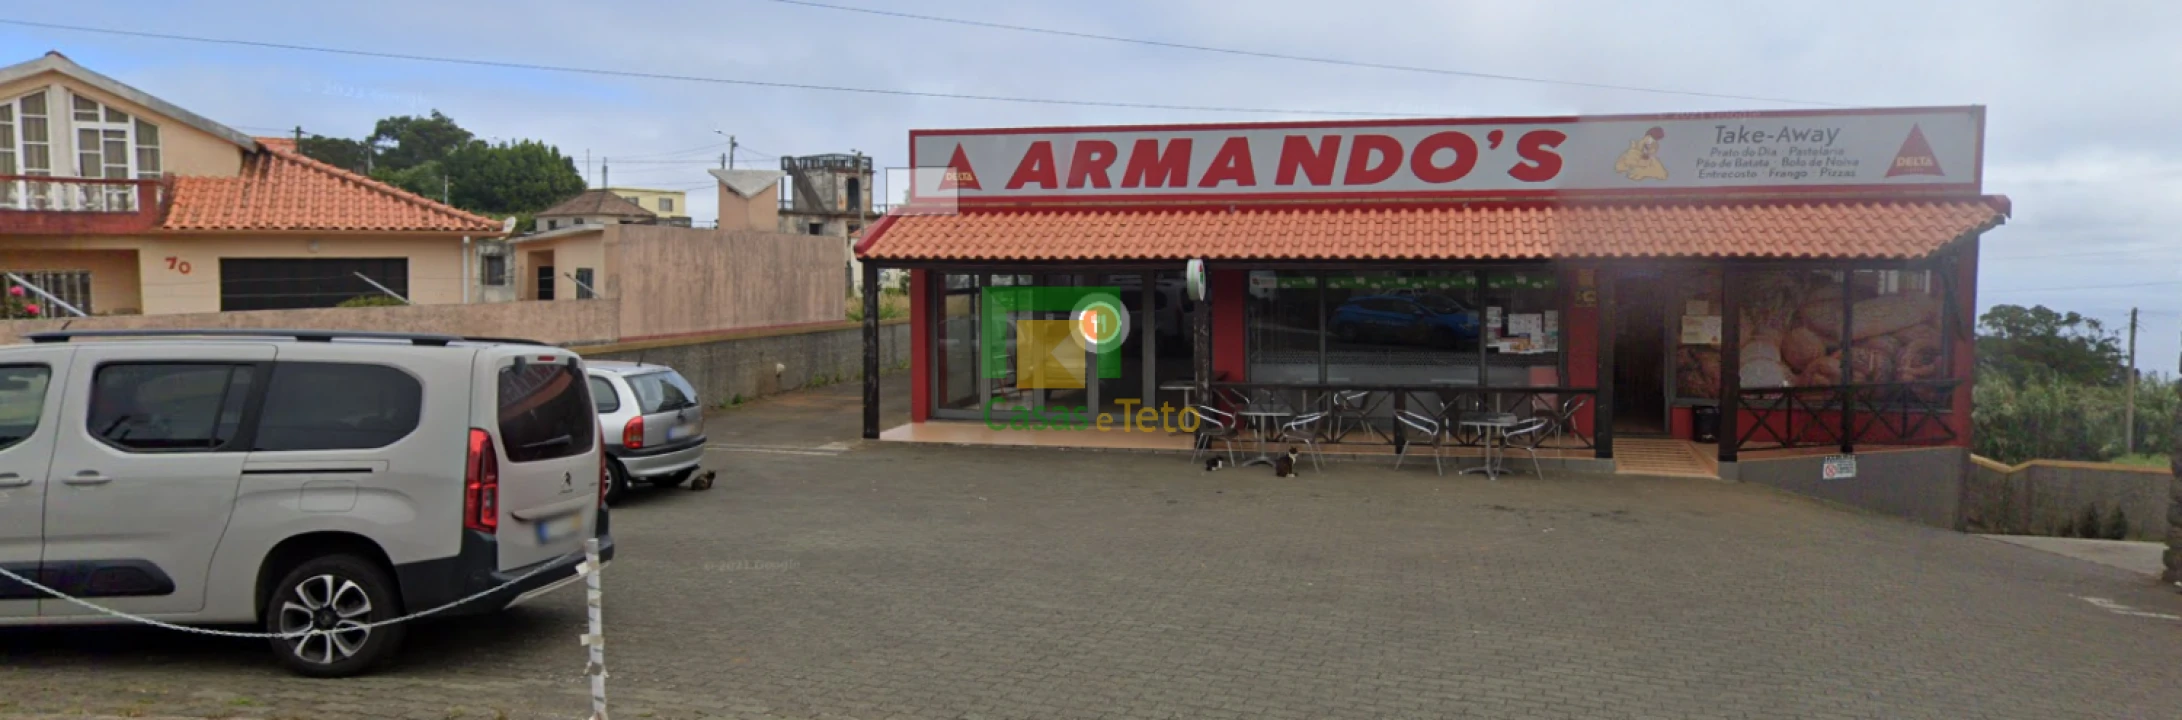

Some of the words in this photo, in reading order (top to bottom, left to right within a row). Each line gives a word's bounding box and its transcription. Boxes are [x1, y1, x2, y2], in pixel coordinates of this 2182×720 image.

[1715, 125, 1841, 147] Take-Away
[1709, 147, 1740, 158] Prato
[1757, 147, 1777, 156] Dia
[1788, 146, 1845, 156] Pastelaria
[1734, 158, 1770, 167] Batata
[1781, 157, 1807, 167] Bolo
[1809, 157, 1823, 167] de
[1896, 156, 1934, 167] DELTA
[945, 172, 974, 181] DELTA
[1698, 170, 1757, 179] Entrecosto
[1768, 168, 1808, 179] Frango
[1820, 167, 1856, 177] Pizzas
[164, 256, 192, 274] 70
